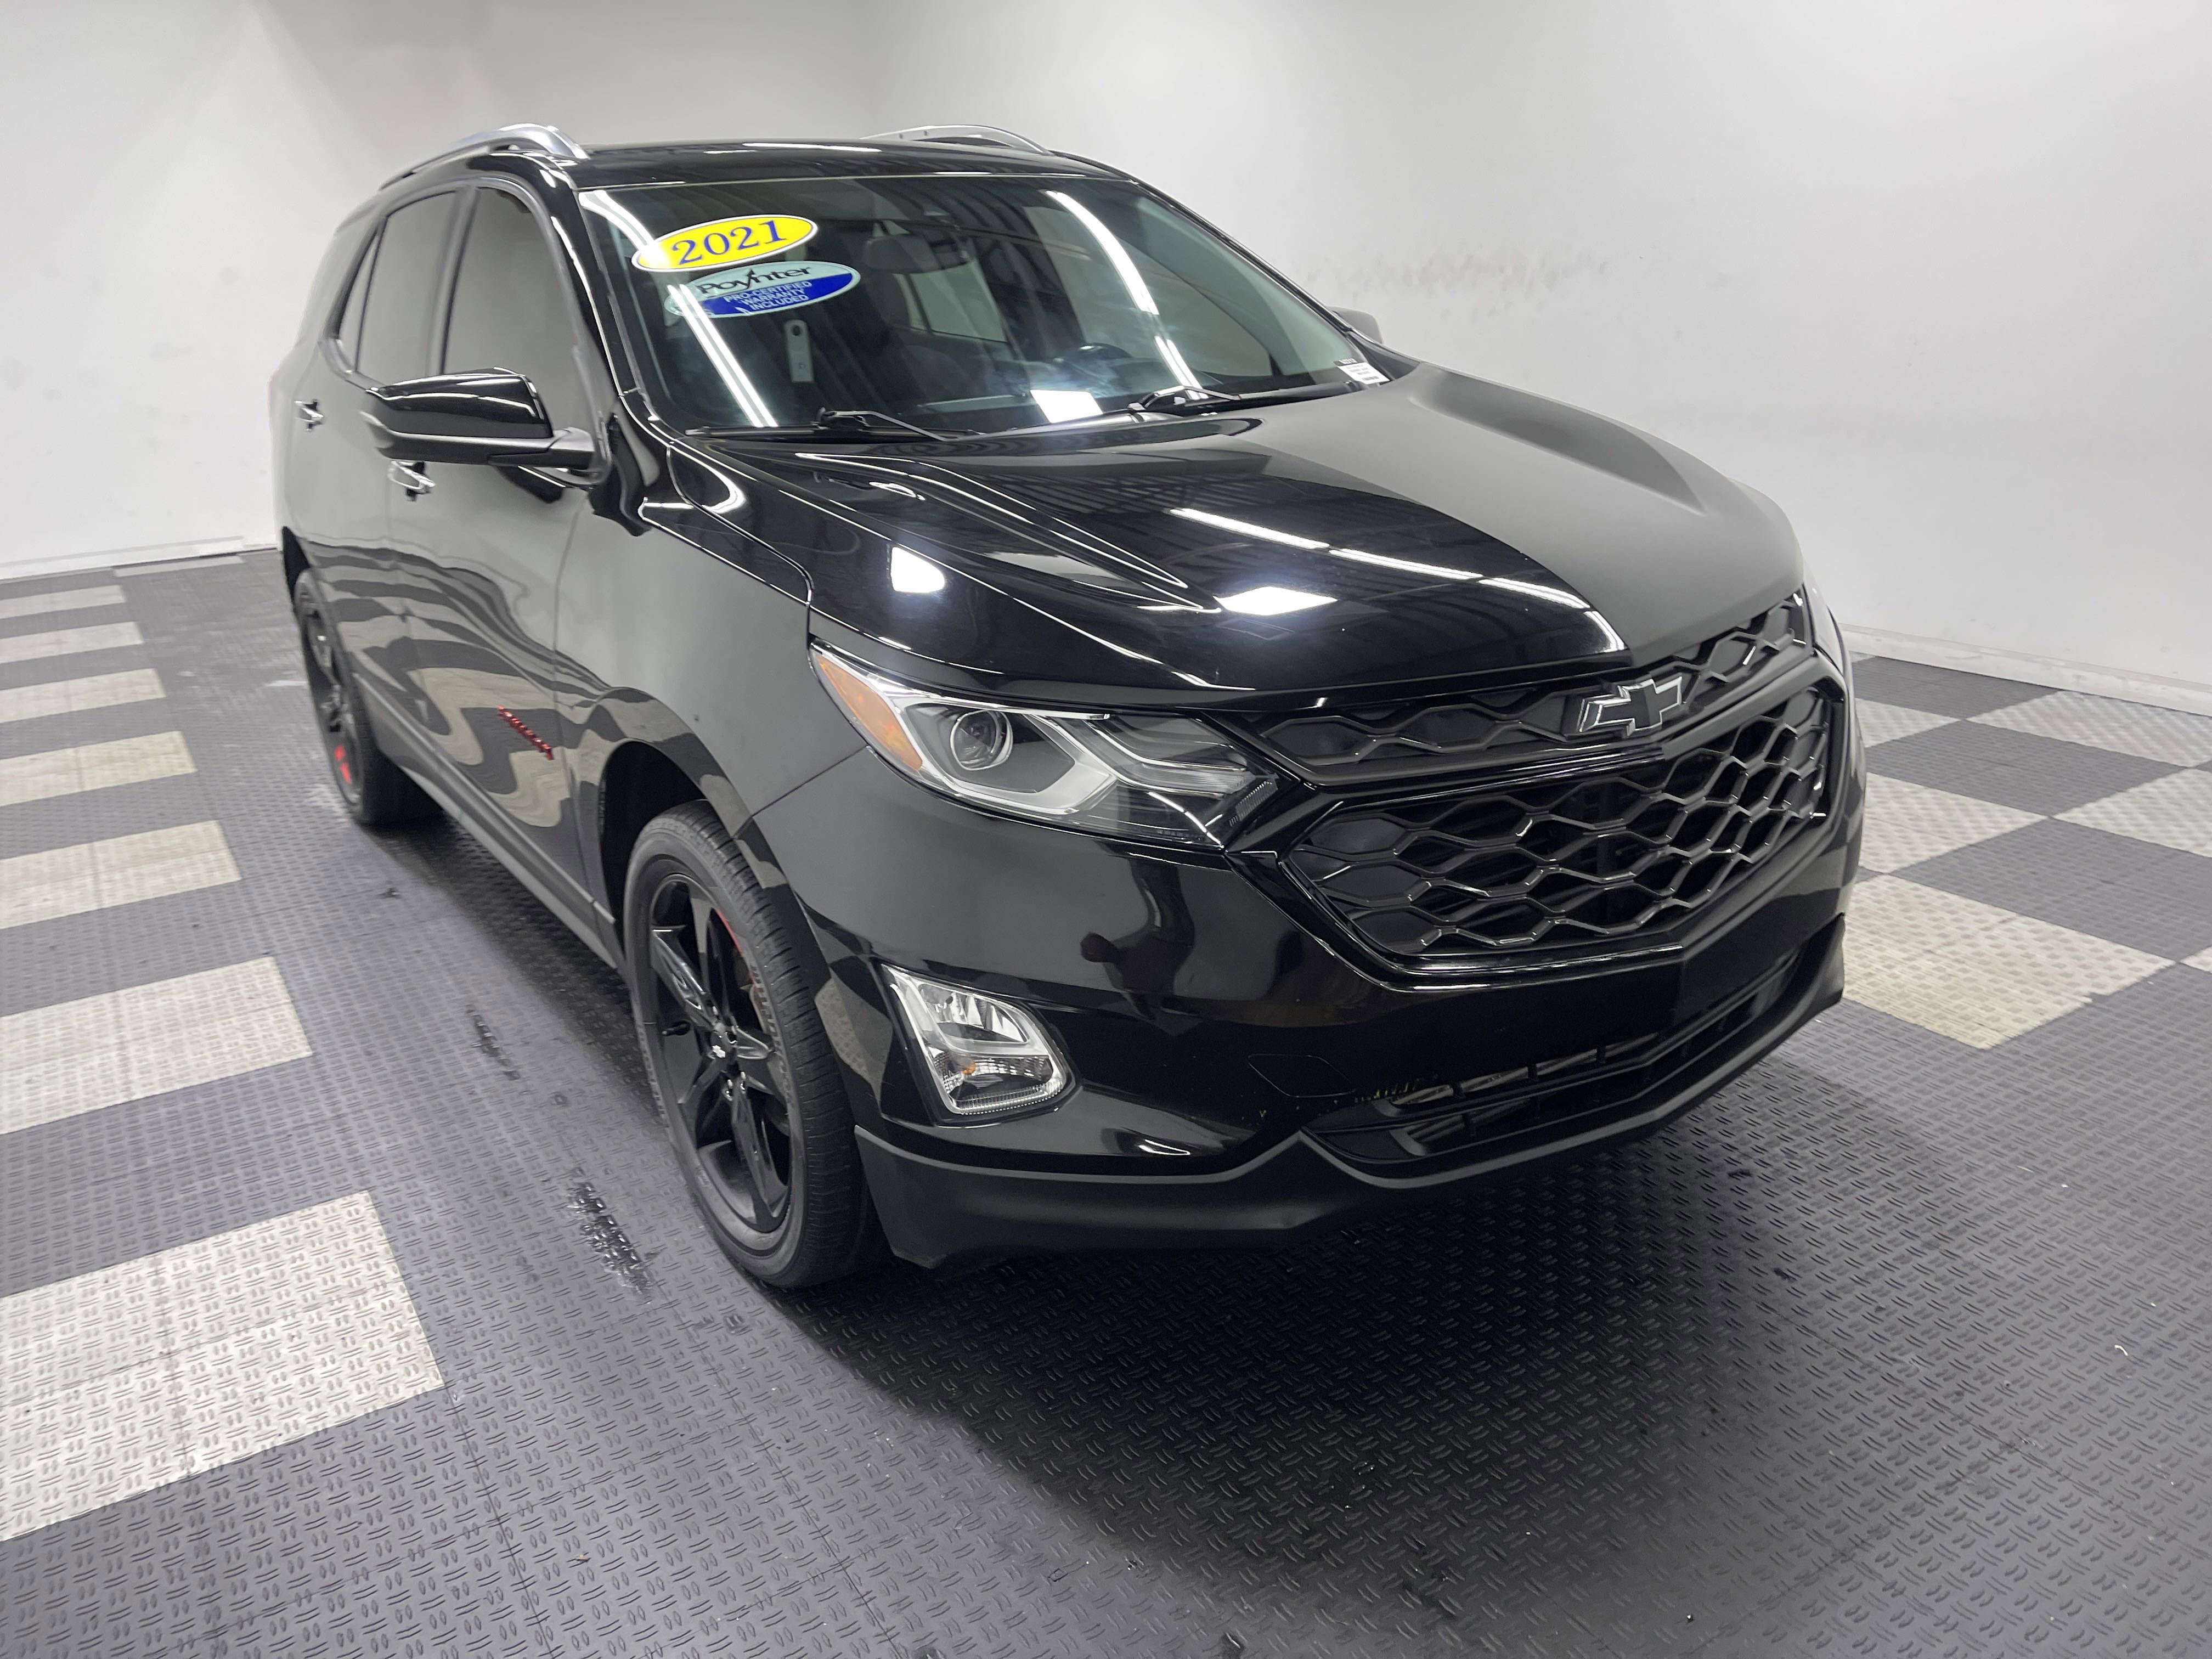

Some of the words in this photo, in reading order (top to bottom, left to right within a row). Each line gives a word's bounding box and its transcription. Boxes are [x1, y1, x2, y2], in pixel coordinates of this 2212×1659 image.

[672, 220, 787, 265] 2021
[697, 268, 810, 294] Poynter
[741, 289, 805, 305] WARRANTY
[750, 295, 809, 310] INCLUDED
